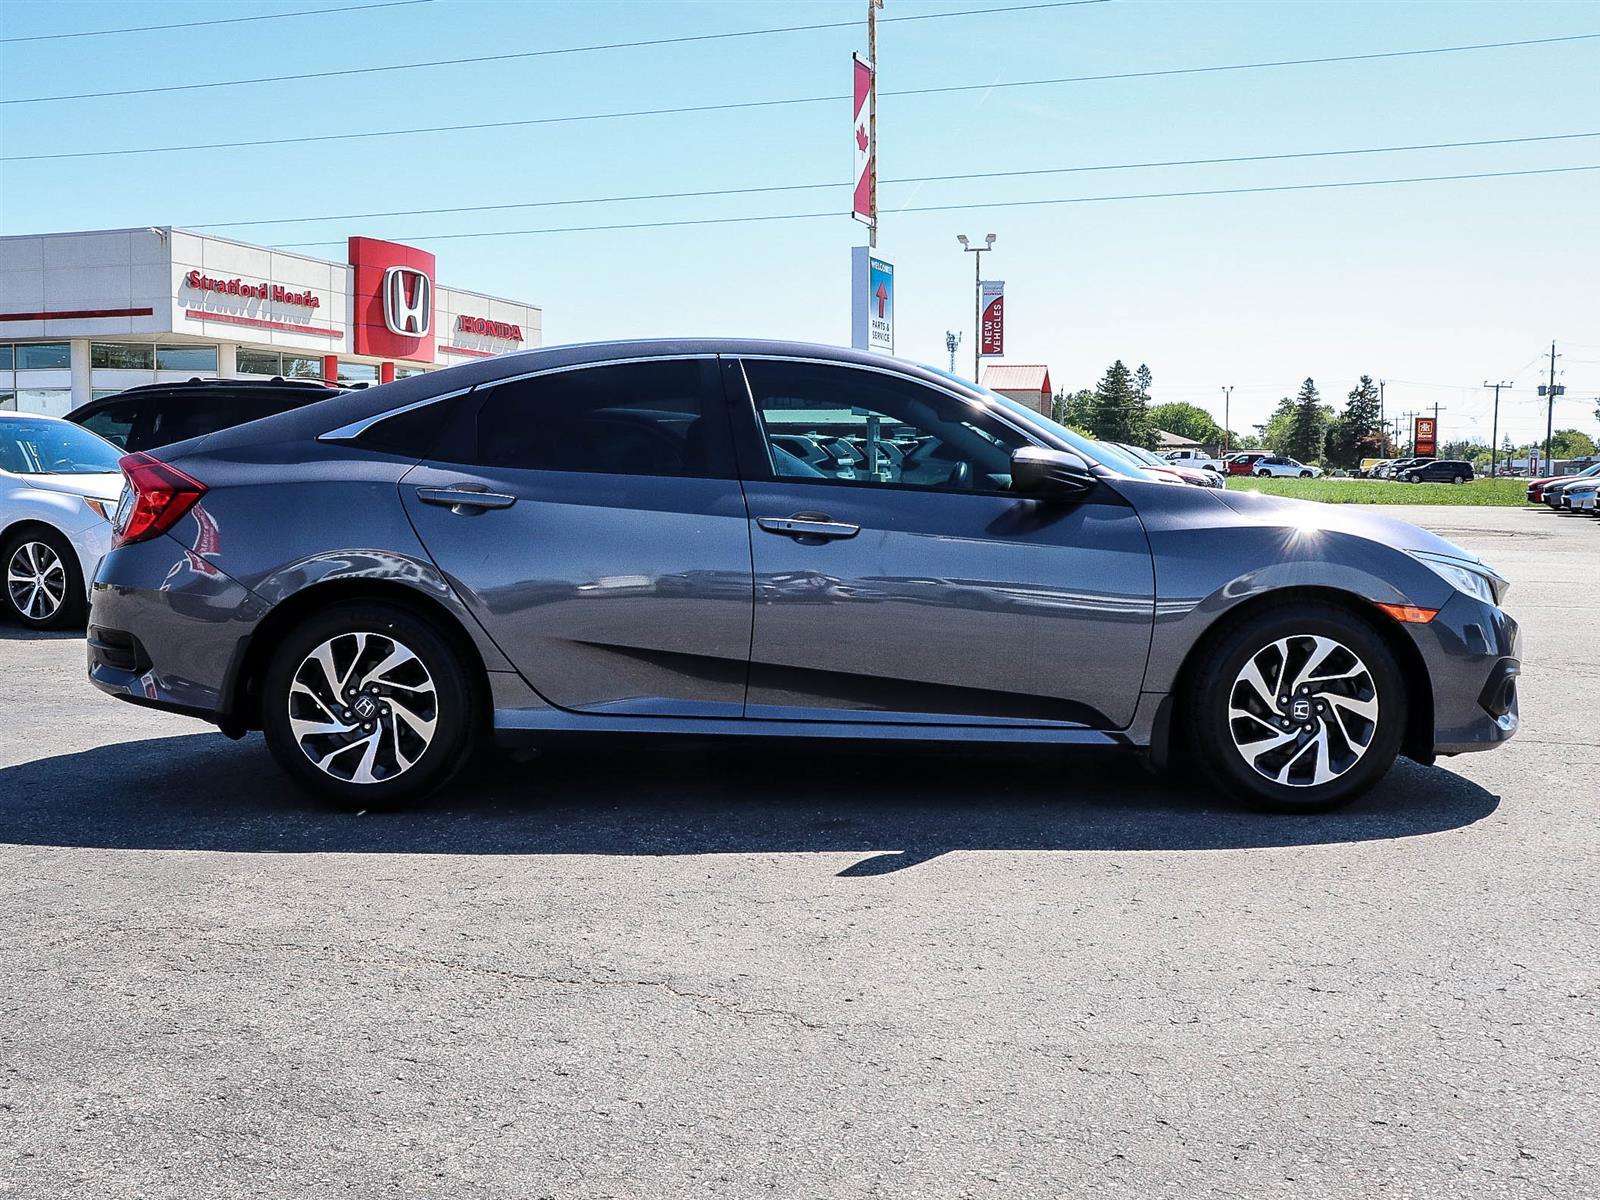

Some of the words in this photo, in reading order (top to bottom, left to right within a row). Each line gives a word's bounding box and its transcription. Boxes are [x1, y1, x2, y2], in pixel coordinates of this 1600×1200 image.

[188, 270, 268, 299] Stratford
[270, 284, 320, 308] Honda
[458, 315, 524, 341] HONDA
[872, 319, 886, 331] PARTS
[984, 321, 993, 344] NEW
[993, 304, 1002, 353] VEHICLES
